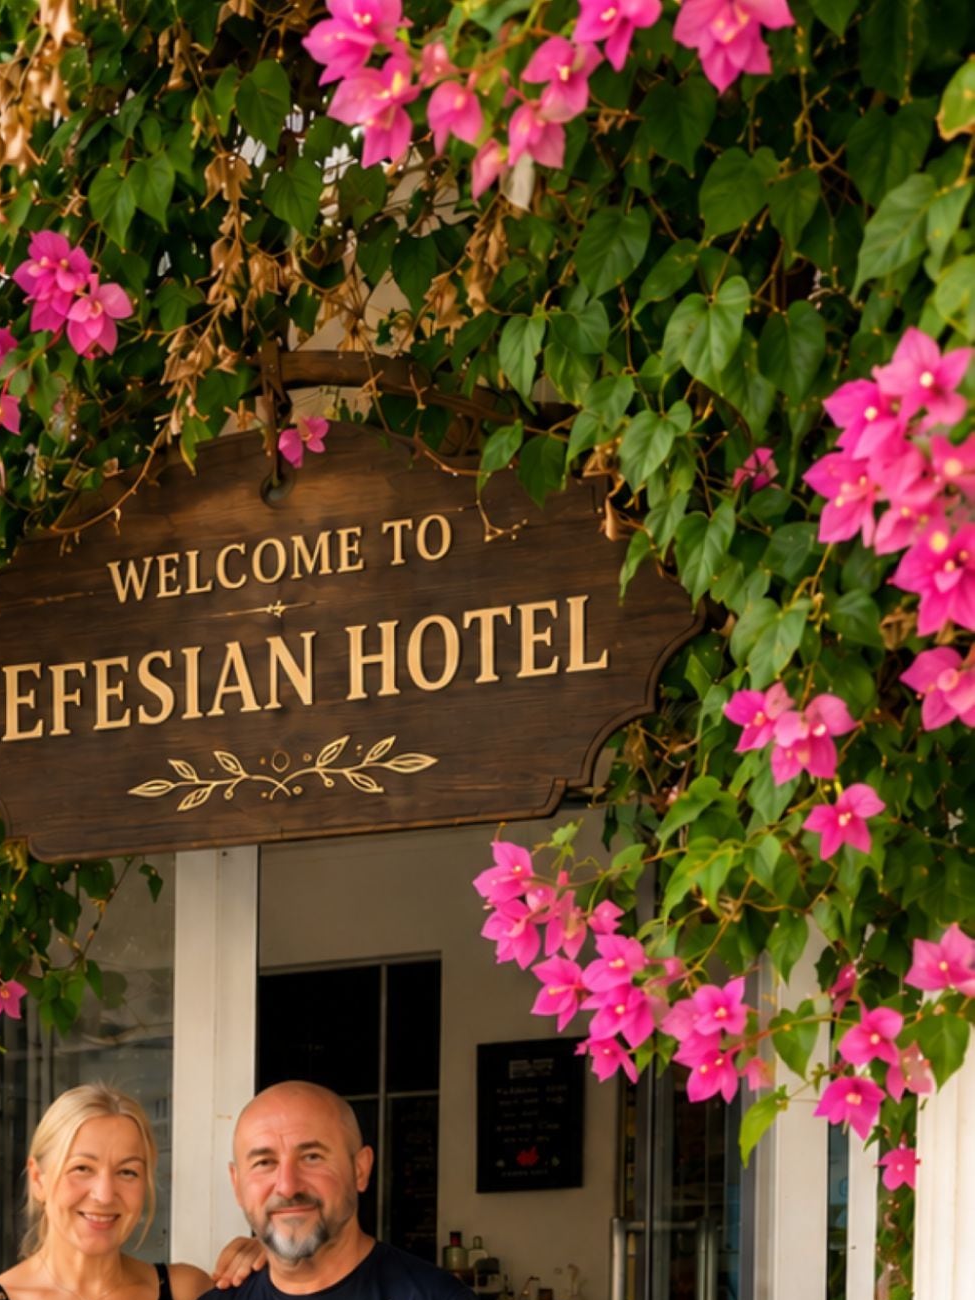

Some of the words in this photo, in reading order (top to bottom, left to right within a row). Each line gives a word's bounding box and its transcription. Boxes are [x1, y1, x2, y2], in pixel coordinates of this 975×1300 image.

[107, 526, 365, 604] WELCOME
[382, 514, 452, 566] TO
[1, 630, 316, 742] EFESIAN
[344, 595, 609, 702] HOTEL
